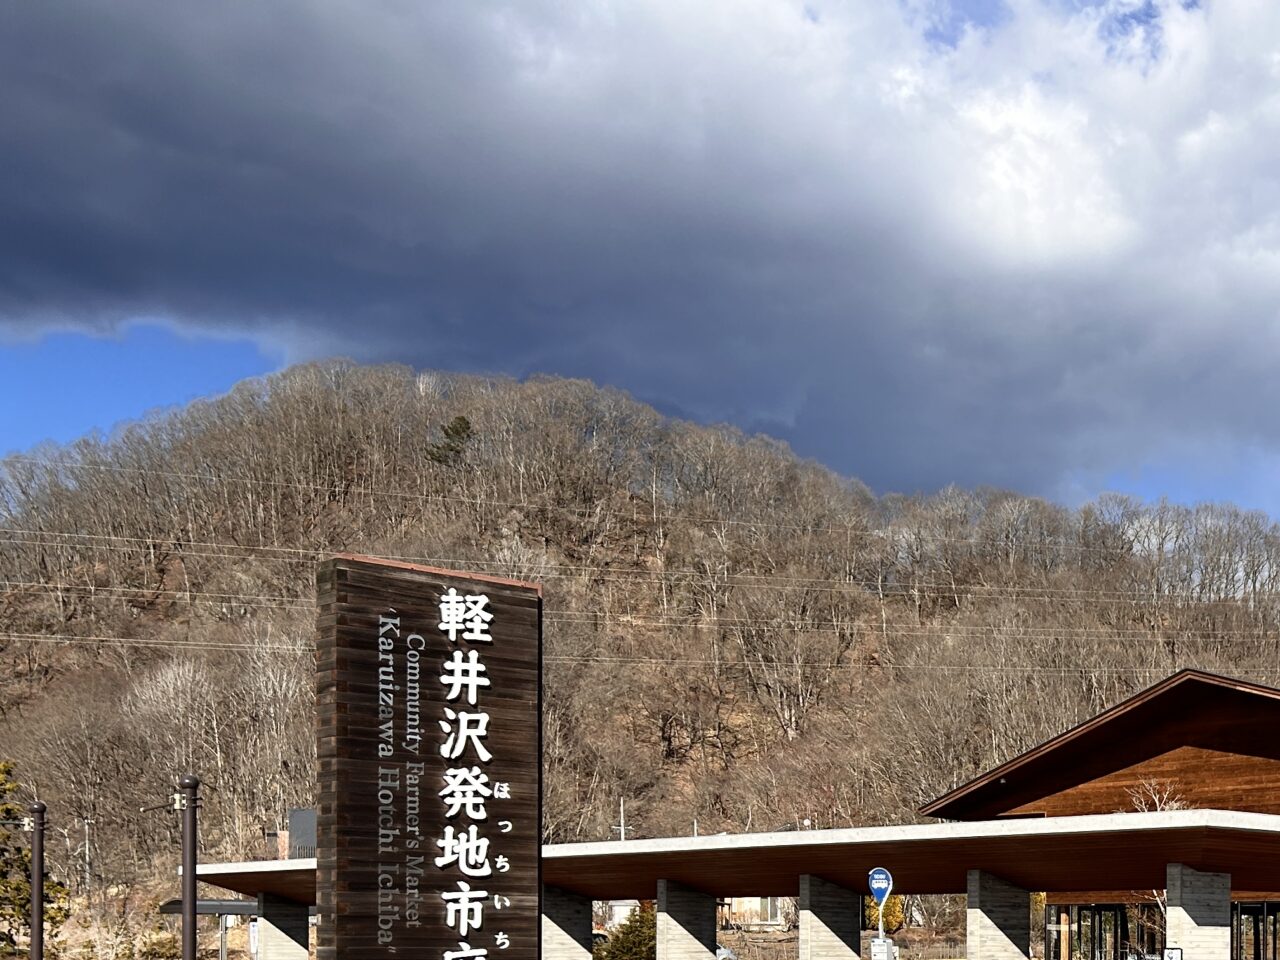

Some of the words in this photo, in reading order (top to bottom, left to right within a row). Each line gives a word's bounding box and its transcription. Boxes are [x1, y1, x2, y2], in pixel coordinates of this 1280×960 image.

[402, 634, 426, 755] Community
[378, 766, 400, 854] Hotchi
[406, 761, 425, 849] Farmer's
[406, 855, 425, 928] Market
